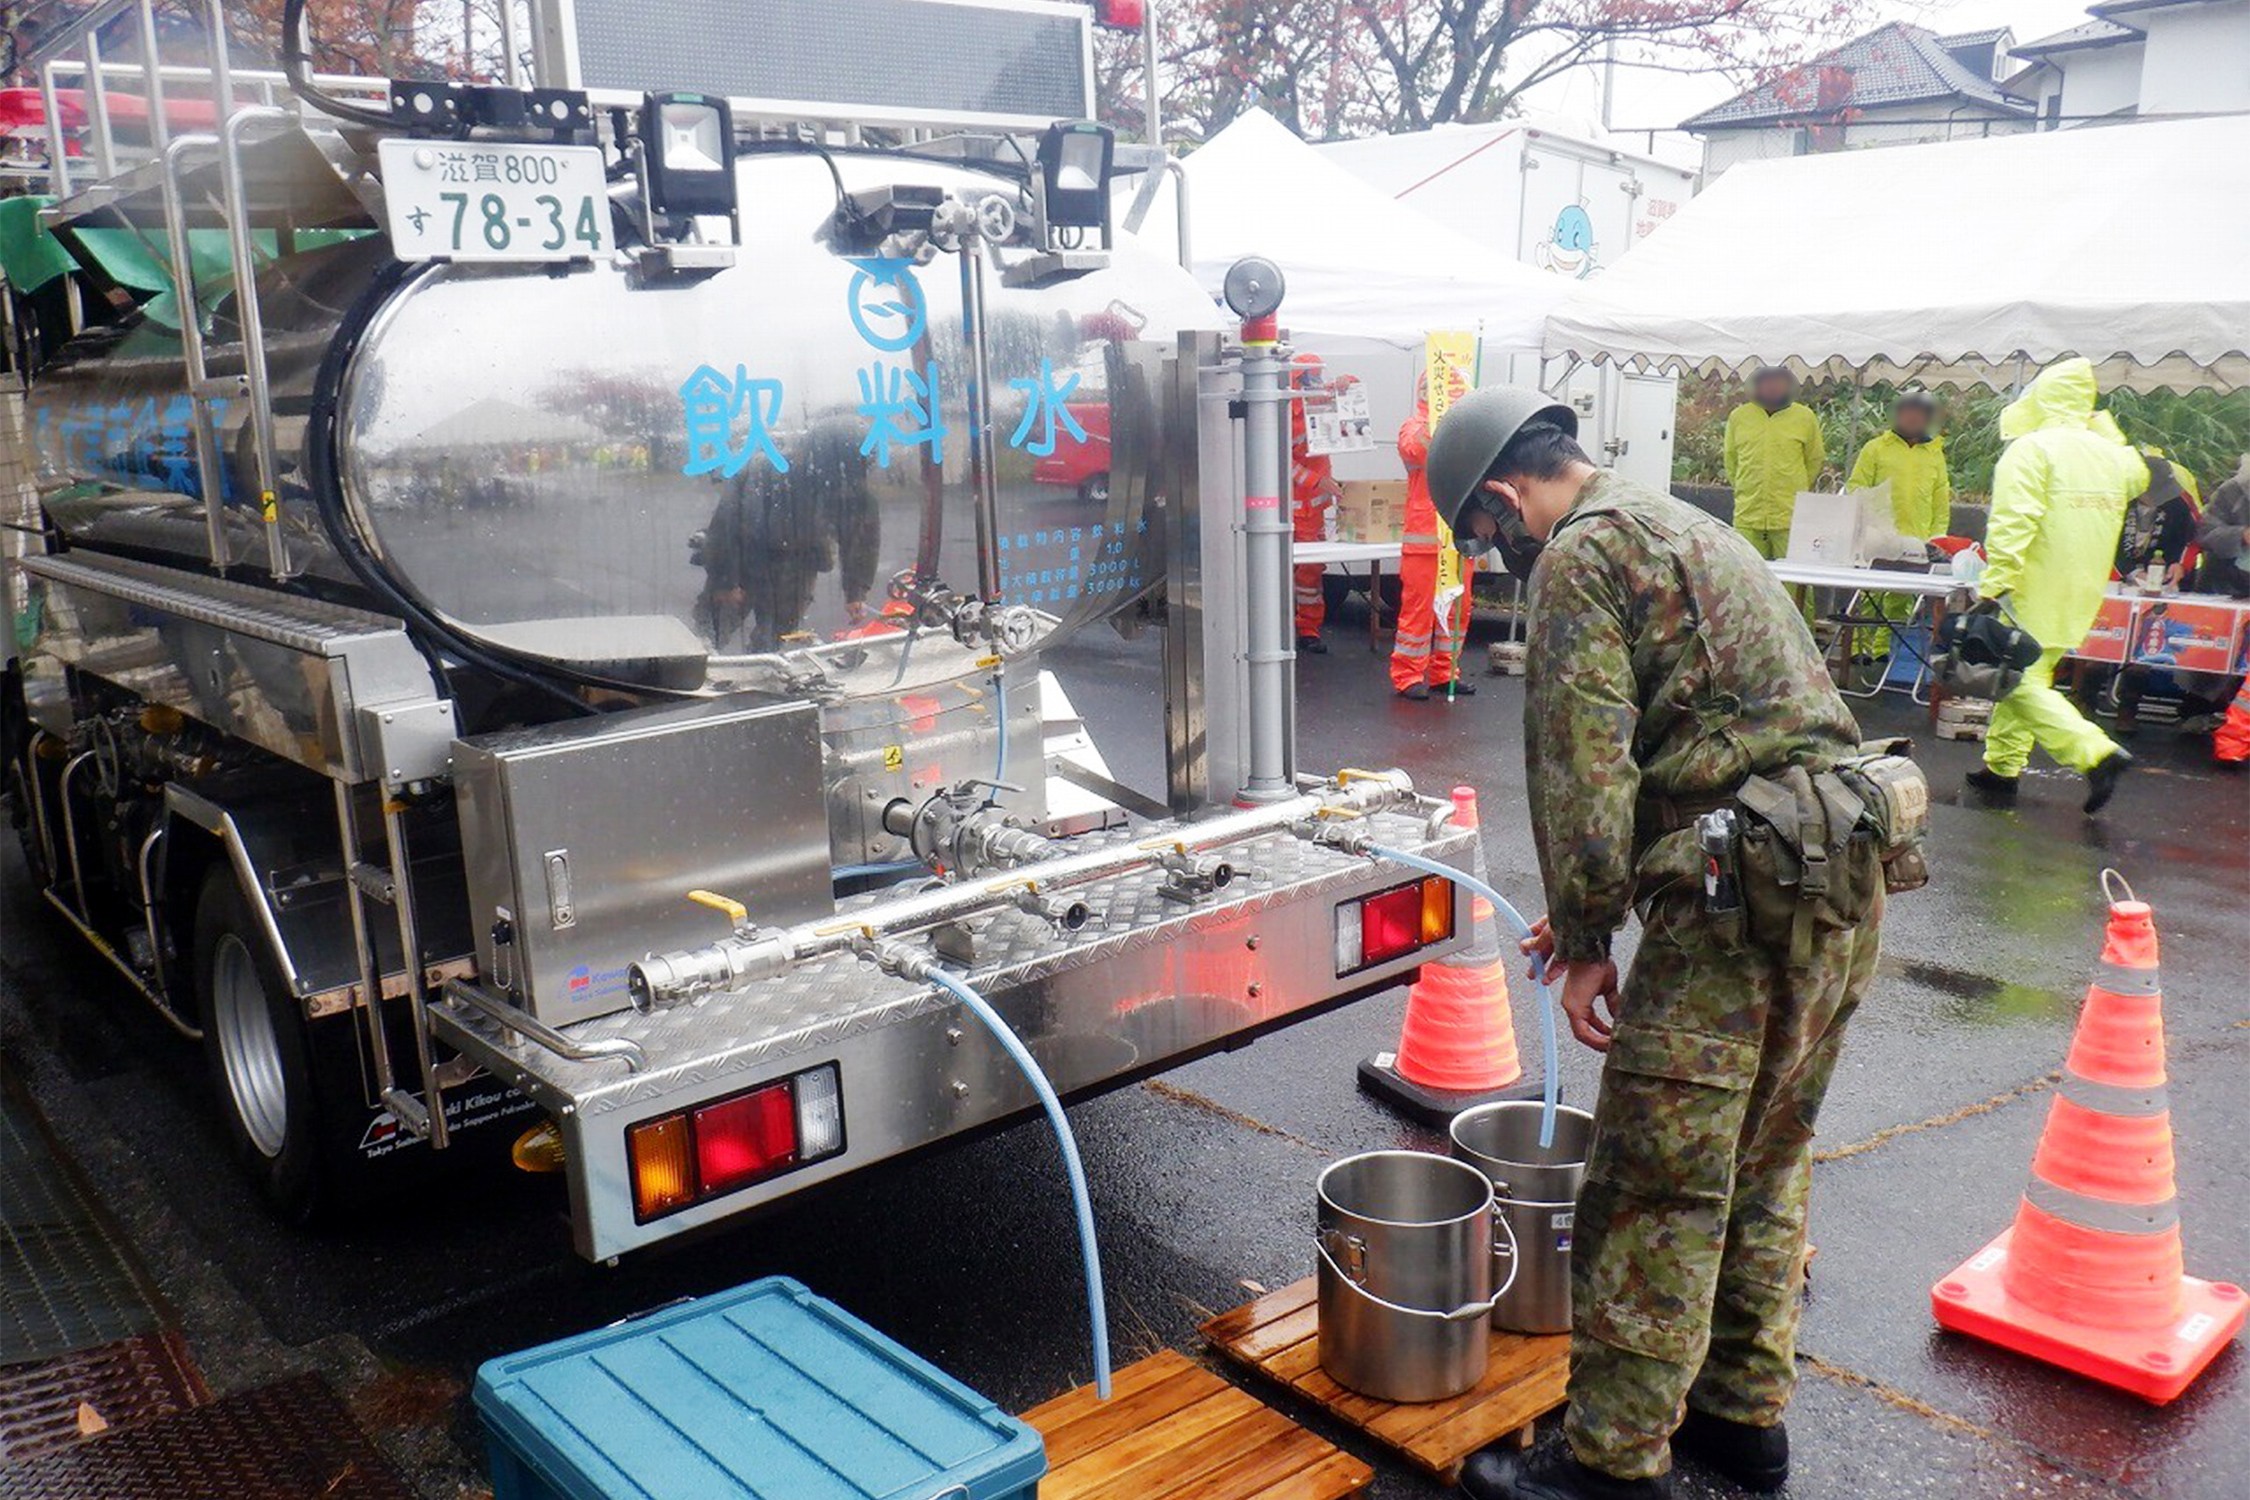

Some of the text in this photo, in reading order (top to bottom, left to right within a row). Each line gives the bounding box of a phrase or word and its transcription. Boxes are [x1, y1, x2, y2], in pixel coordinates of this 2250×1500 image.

[406, 193, 601, 250] す 78-34
[680, 357, 1087, 479] 飲料水
